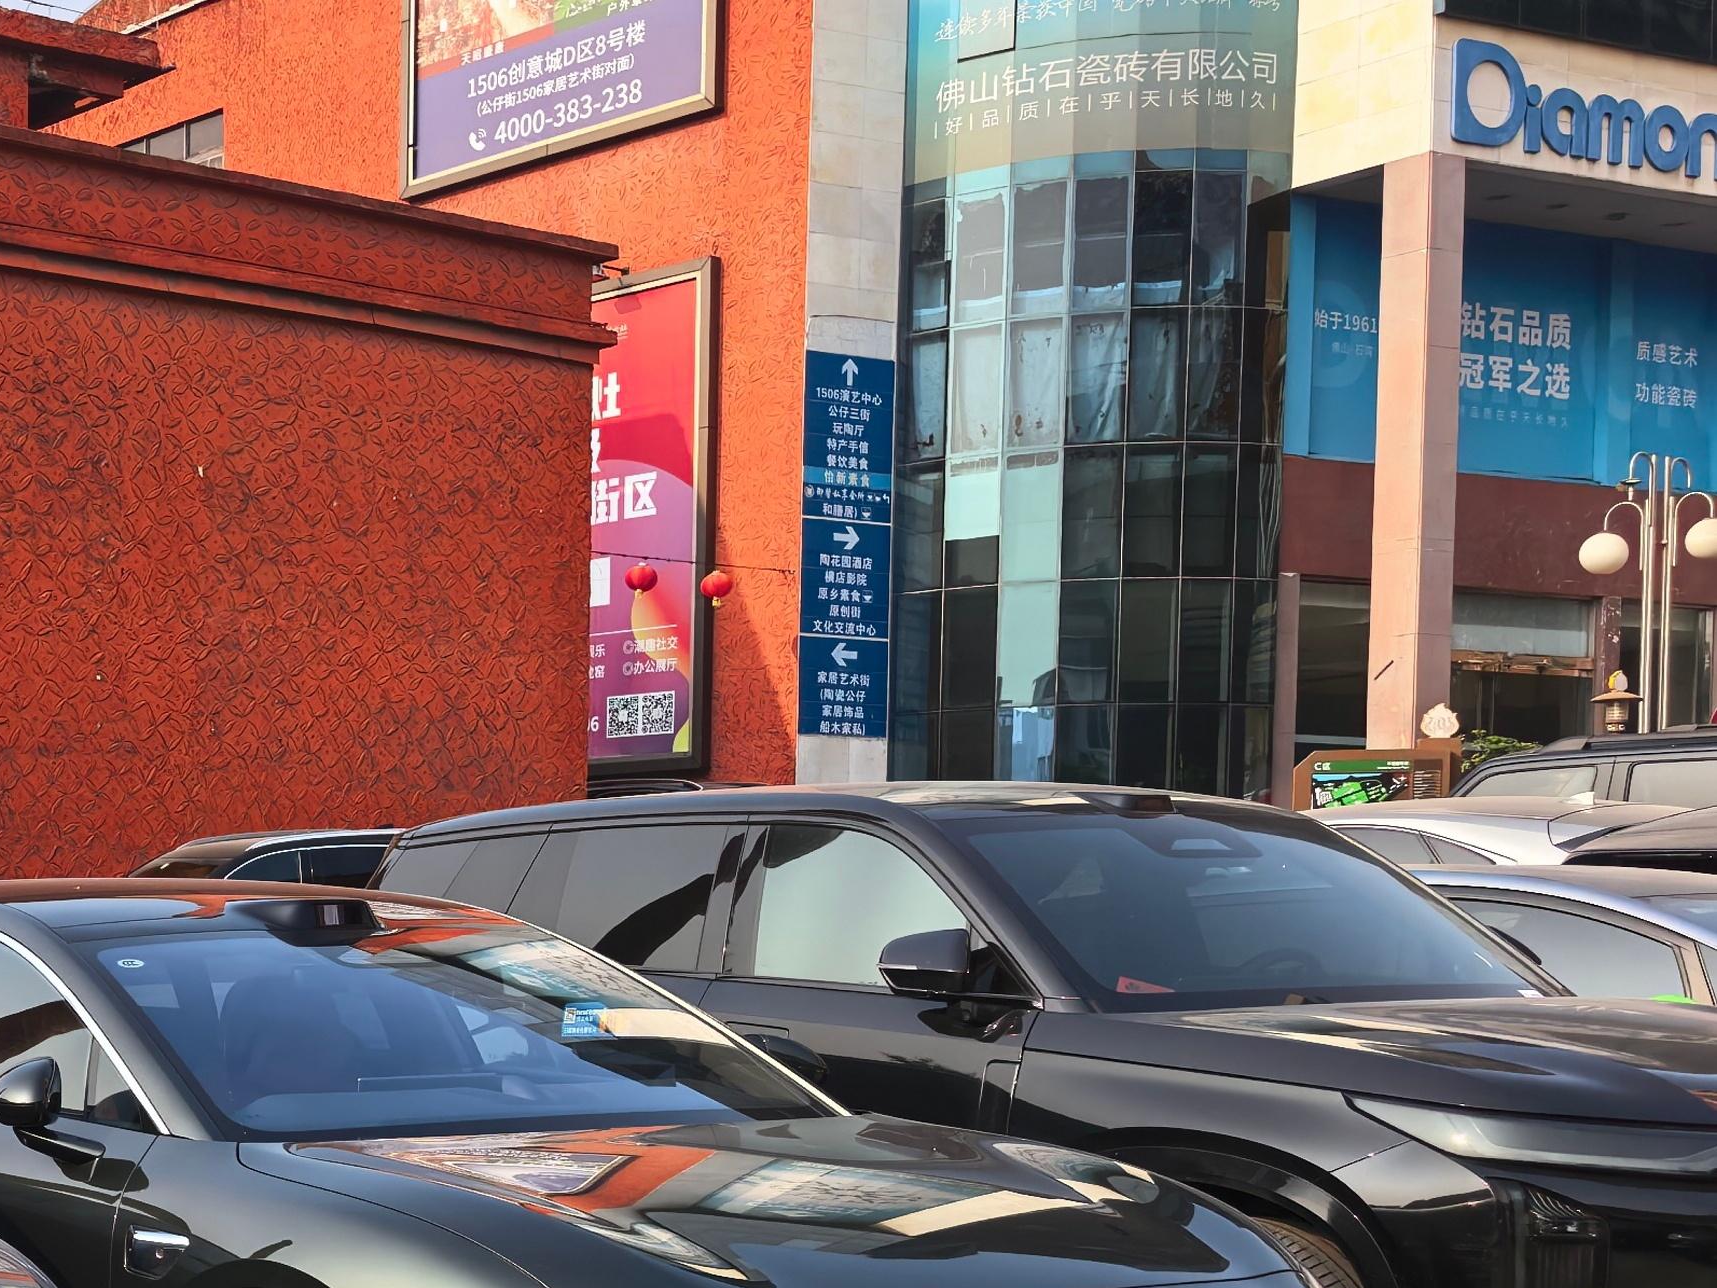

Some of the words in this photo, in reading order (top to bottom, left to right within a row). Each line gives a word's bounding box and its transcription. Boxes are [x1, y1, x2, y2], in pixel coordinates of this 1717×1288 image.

[467, 19, 646, 98] 1506创意城D区8号楼
[936, 48, 1277, 113] 佛山钻石瓷砖有限公司
[494, 79, 643, 145] 4000-383-238
[1451, 37, 1717, 182] Diamon
[1314, 308, 1378, 333] 始于1961
[1461, 302, 1571, 351] 钻石品质
[1636, 341, 1699, 368] 质感艺术
[1459, 351, 1571, 400] 冠军之选
[815, 387, 882, 406] 1506演艺中心
[1634, 382, 1698, 409] 功能瓷砖
[828, 405, 870, 422] 公仔三街
[826, 437, 869, 454] 特产手信
[826, 454, 869, 470] 餐饮美食
[829, 605, 861, 619] 原创街
[813, 620, 876, 636] 文化交流中心
[817, 671, 870, 687] 家居艺术街
[822, 704, 864, 719] 家居饰品
